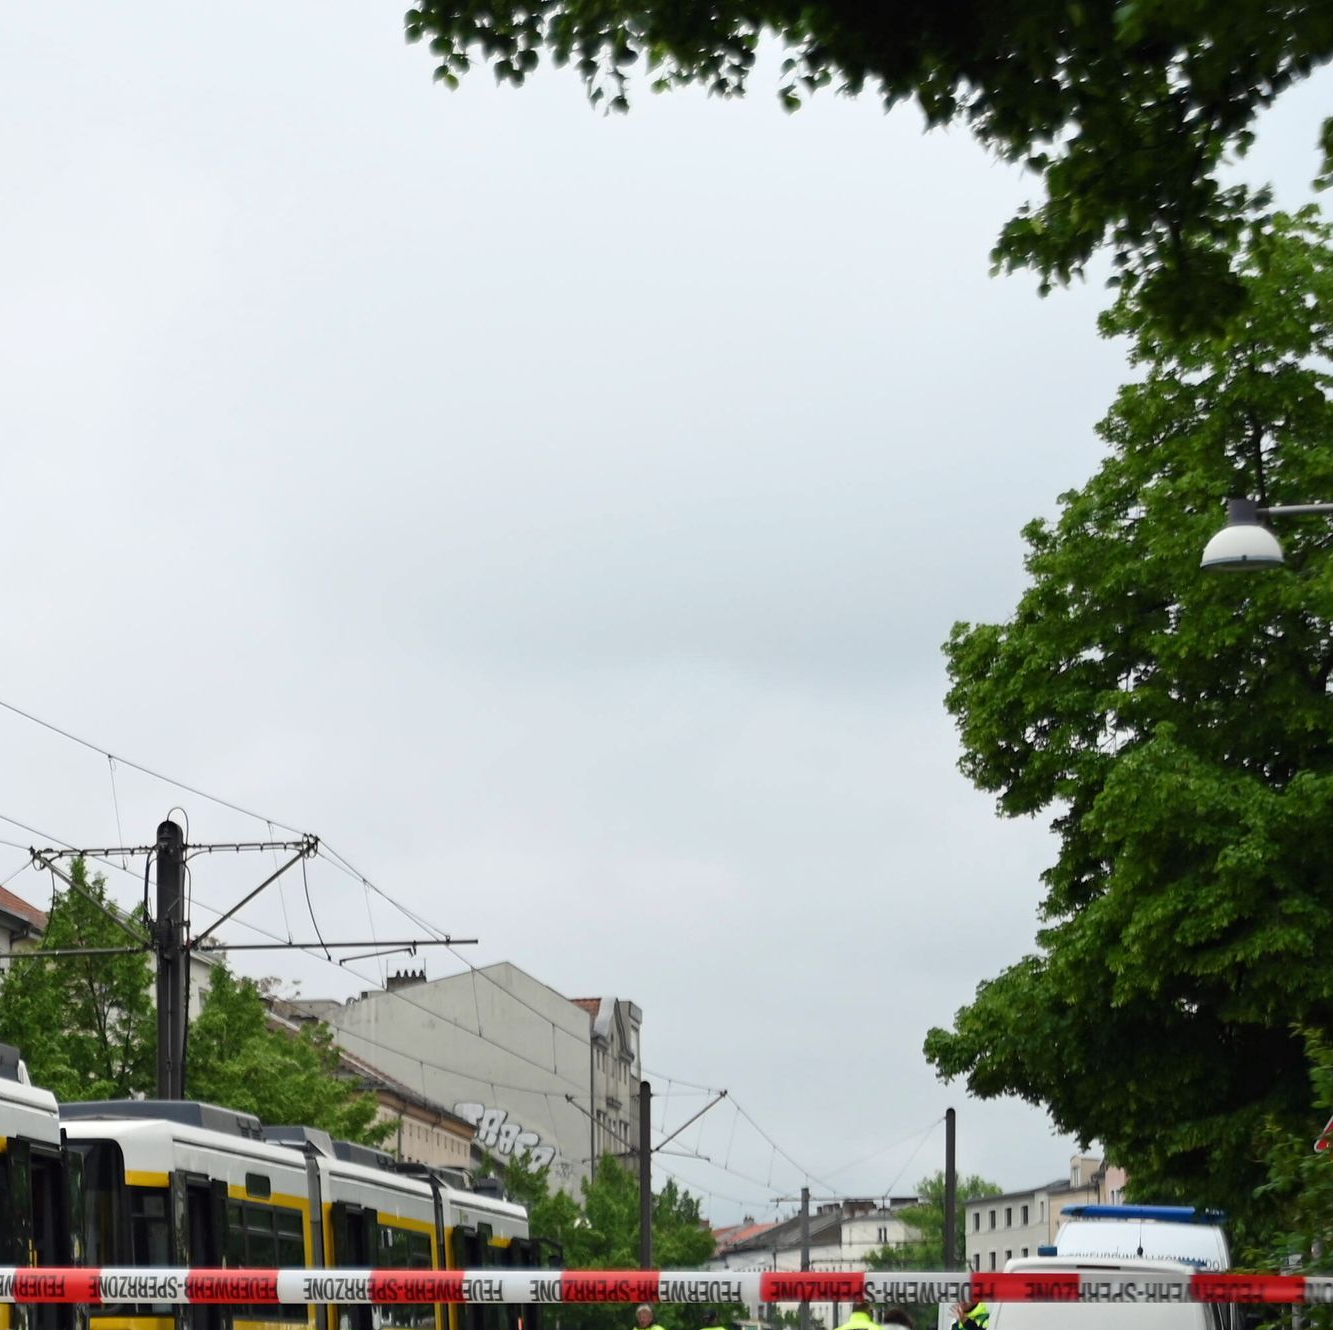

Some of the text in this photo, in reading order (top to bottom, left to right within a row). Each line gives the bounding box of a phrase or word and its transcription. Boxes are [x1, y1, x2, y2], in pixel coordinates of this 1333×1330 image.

[89, 1275, 278, 1301] FEUERWEHR-SPERRZONE
[303, 1278, 503, 1301] FEUERWEHR-SPERRZONE
[530, 1279, 741, 1302] FEUERWEHR-SPERRZONE
